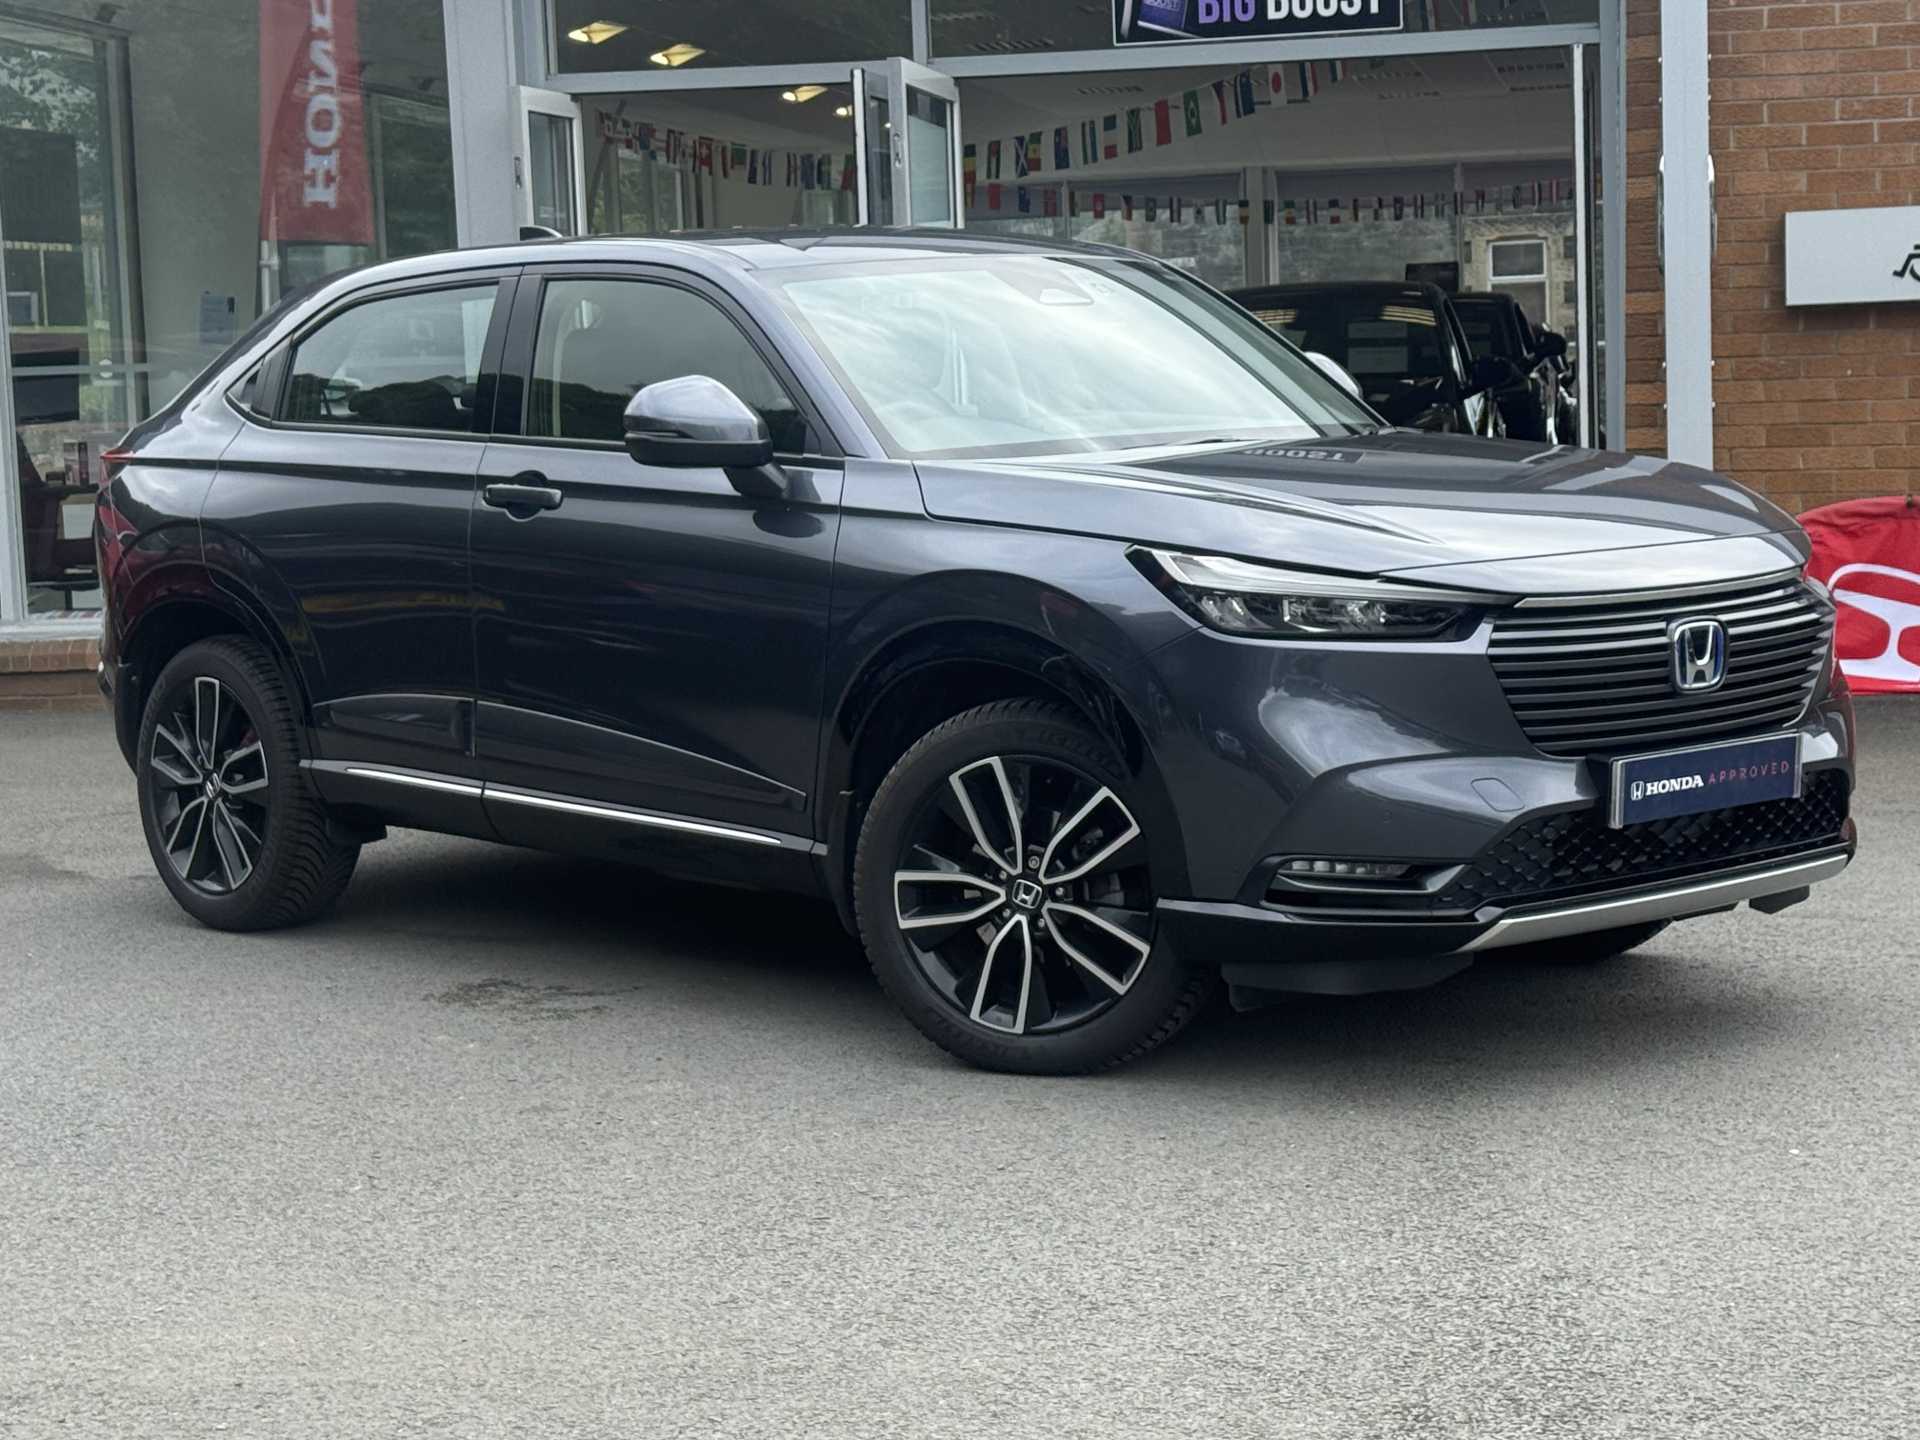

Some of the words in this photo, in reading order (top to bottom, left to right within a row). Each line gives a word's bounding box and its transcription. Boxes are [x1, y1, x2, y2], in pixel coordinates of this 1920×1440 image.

[1198, 0, 1256, 24] BIG
[1645, 775, 1704, 796] HONDA
[1708, 760, 1790, 785] APPROVED
